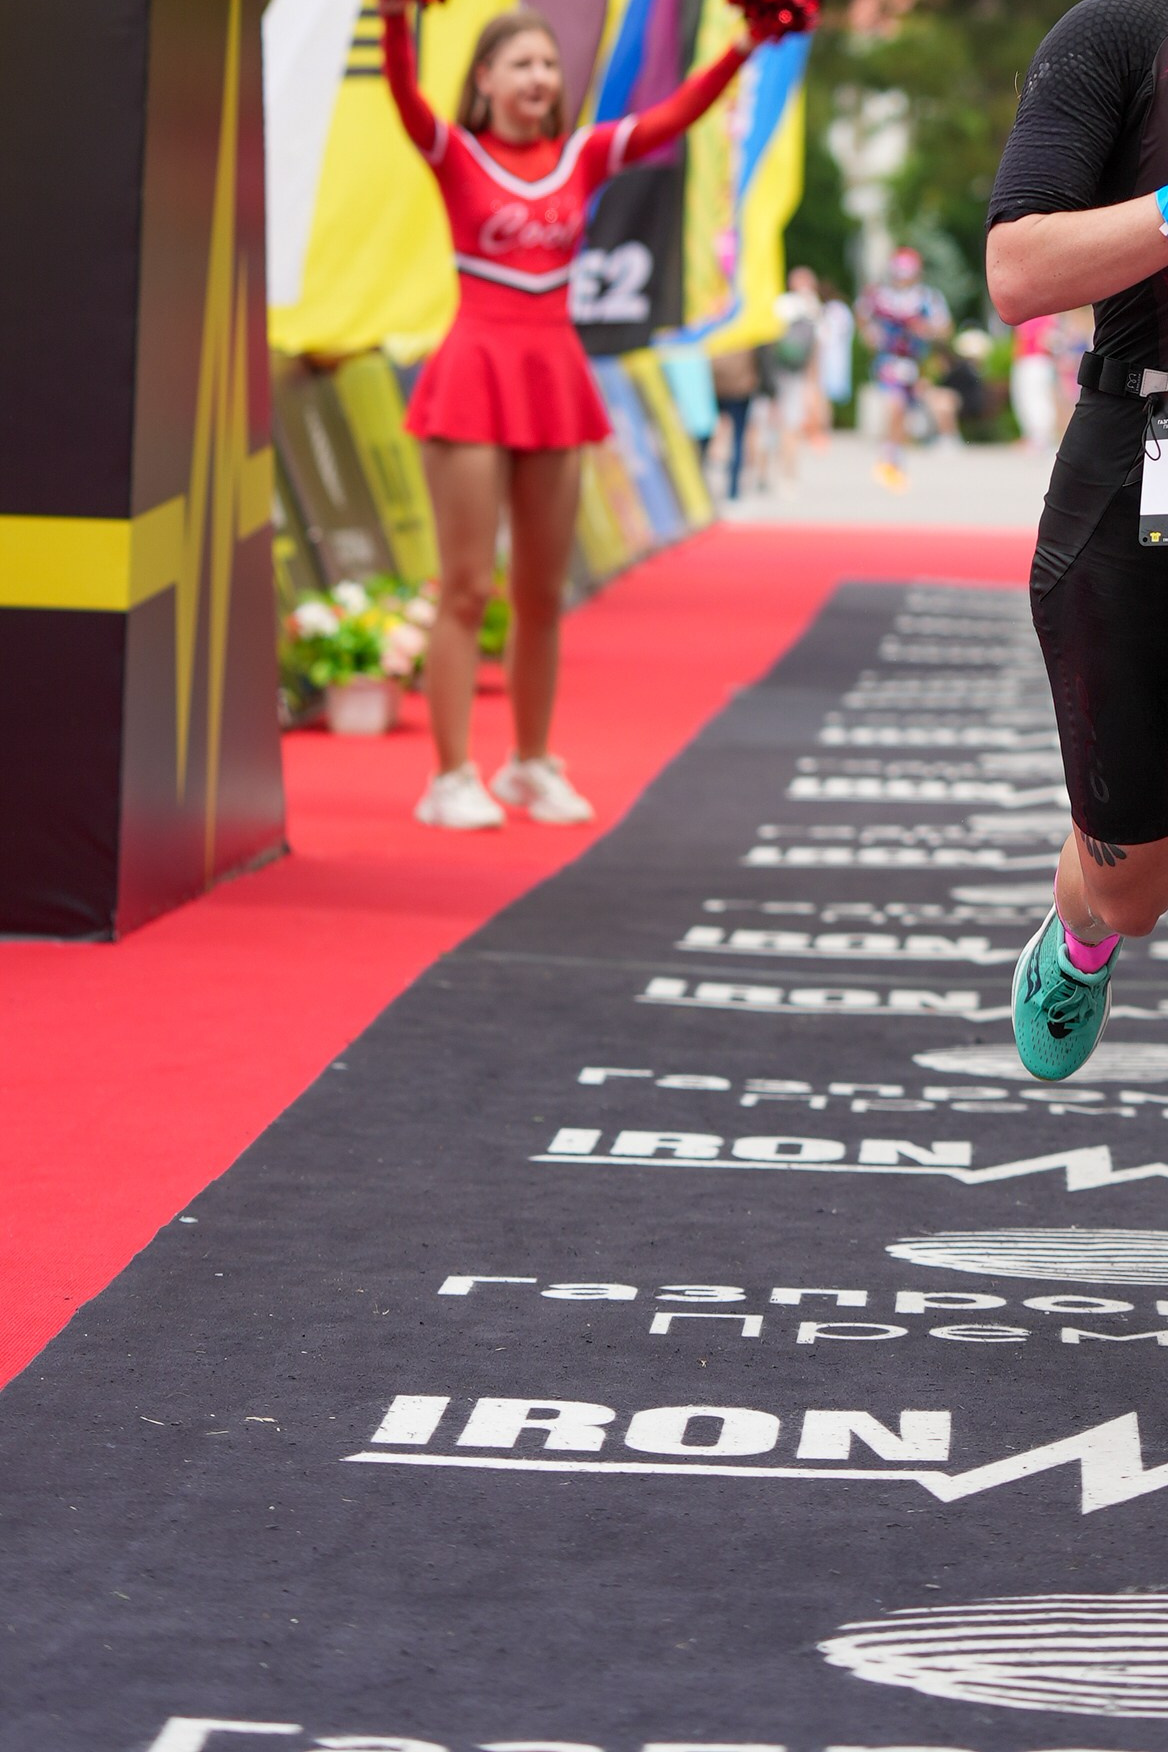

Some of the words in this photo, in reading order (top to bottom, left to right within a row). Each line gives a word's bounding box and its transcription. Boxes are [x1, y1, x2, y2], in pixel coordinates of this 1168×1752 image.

[644, 977, 980, 1010] IRON
[548, 1128, 972, 1167] IRON
[371, 1395, 951, 1461] IRON
